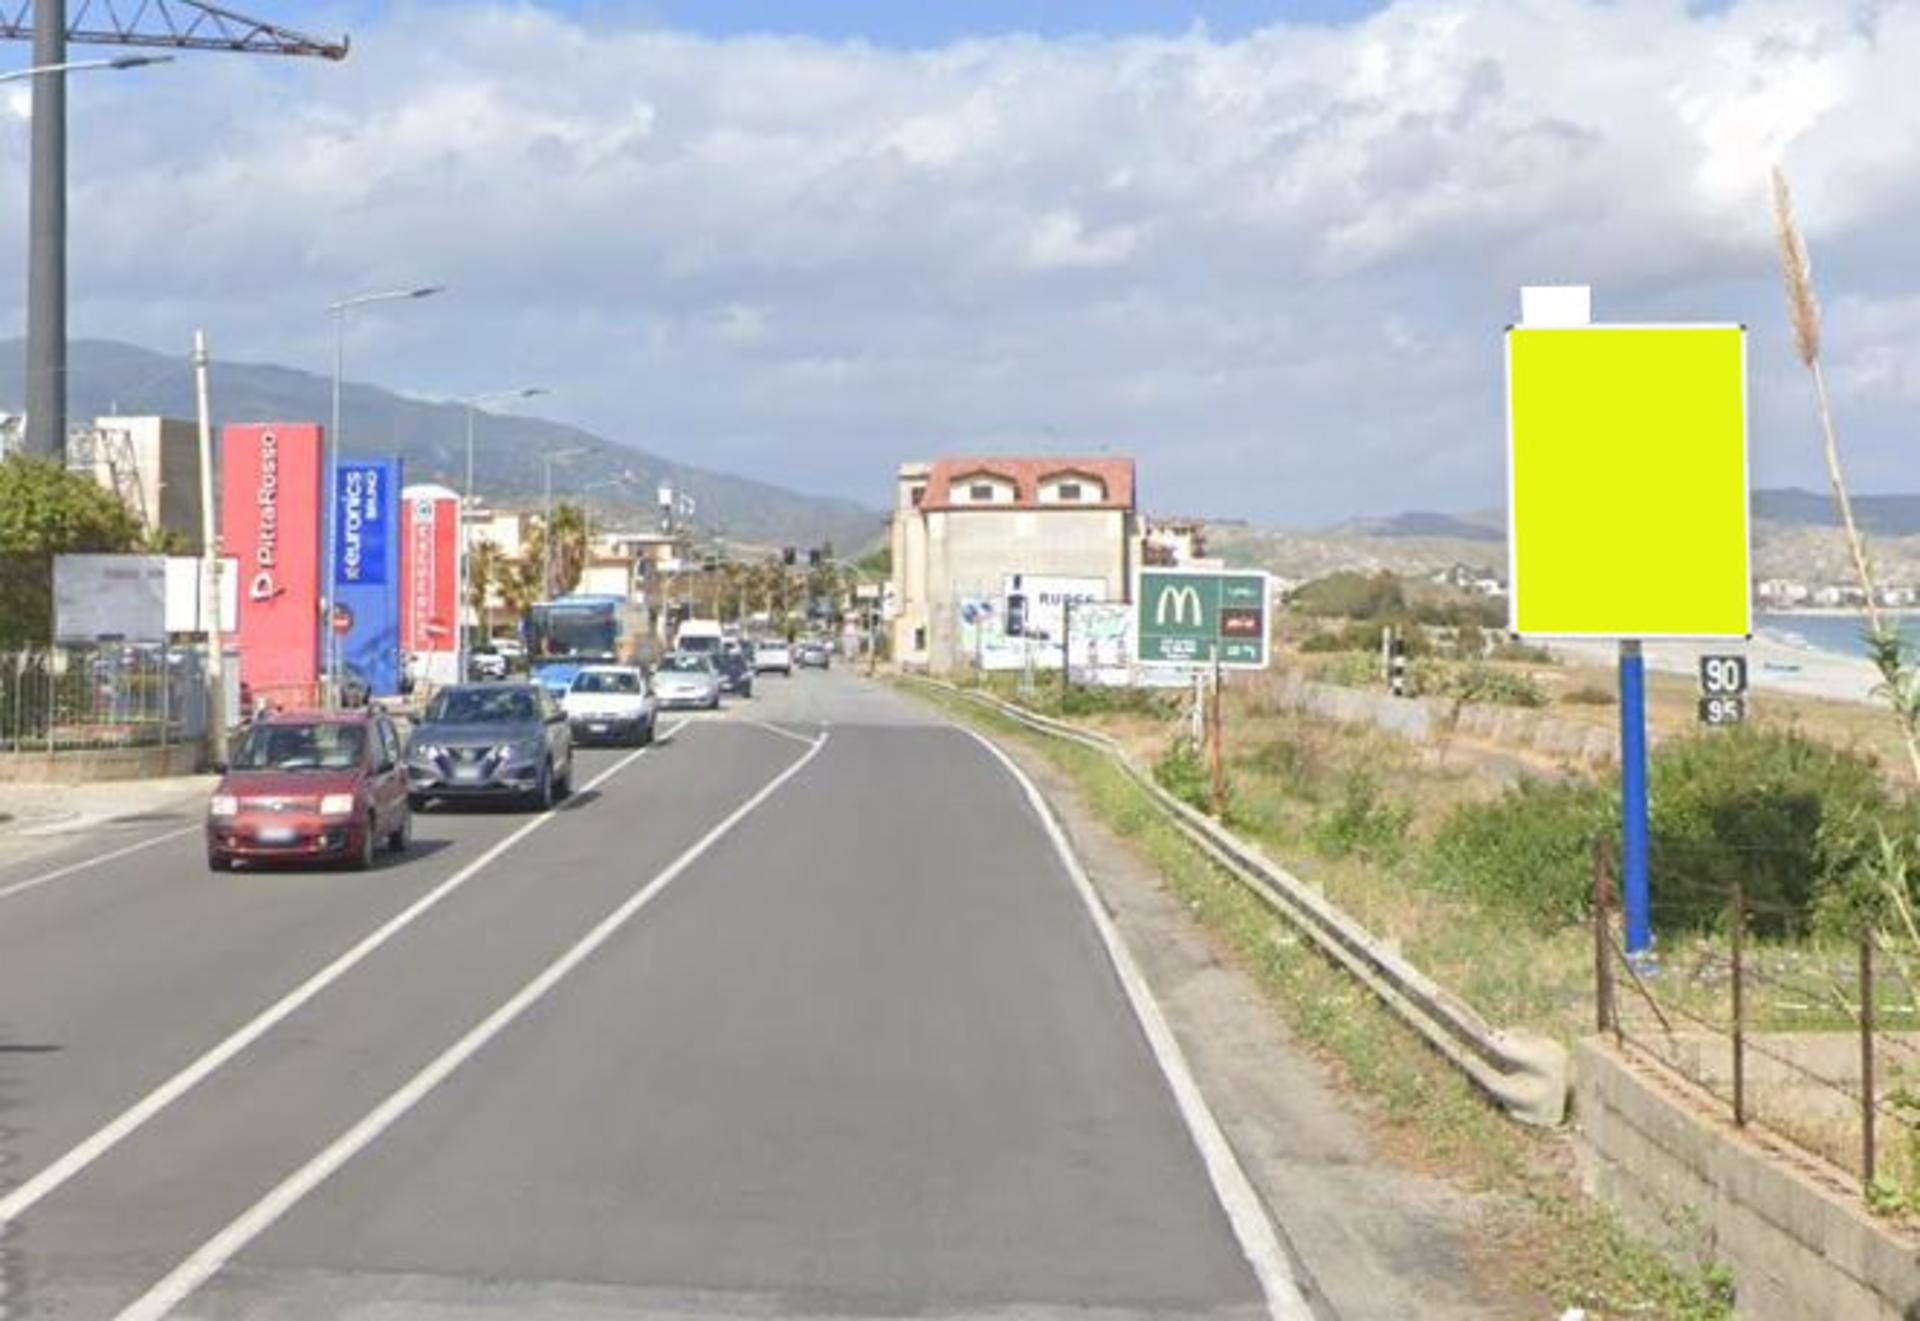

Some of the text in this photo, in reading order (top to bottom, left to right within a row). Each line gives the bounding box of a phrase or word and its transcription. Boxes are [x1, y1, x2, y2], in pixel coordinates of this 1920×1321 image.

[257, 430, 276, 568] PittaRosso
[343, 471, 362, 566] euronics
[1707, 659, 1739, 691] 90
